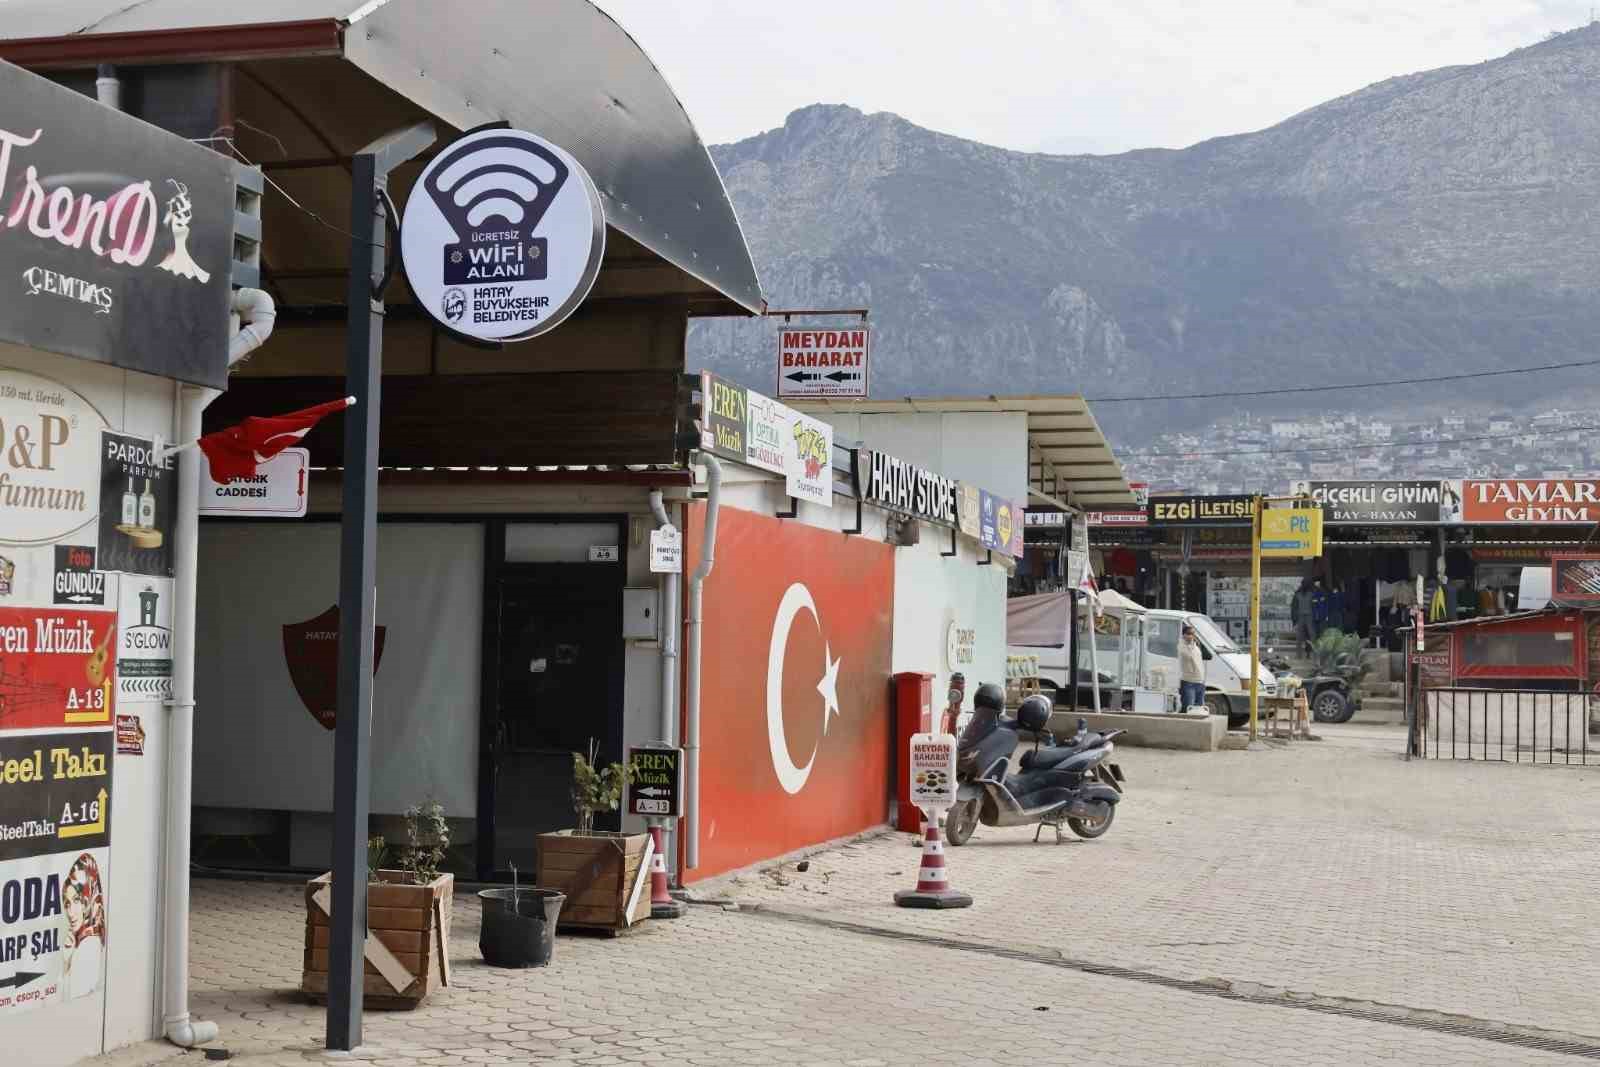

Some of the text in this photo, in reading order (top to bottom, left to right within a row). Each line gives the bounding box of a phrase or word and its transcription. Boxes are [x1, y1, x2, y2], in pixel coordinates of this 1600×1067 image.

[468, 242, 524, 264] WİFİ
[466, 264, 525, 279] ALANI
[472, 286, 513, 297] HATAY
[783, 331, 864, 348] MEYDAN
[783, 352, 863, 367] BAHARAT
[713, 382, 746, 424] EREN
[0, 413, 70, 471] &P
[215, 487, 267, 497] CADDESİ
[872, 450, 915, 509] HATAY
[917, 468, 955, 522] STORE
[1312, 483, 1439, 507] ÇİÇEKLİ GİYİM
[1471, 482, 1600, 503] TAMAR
[1154, 499, 1196, 519] EZGİ
[1505, 504, 1588, 521] GİYİM
[1290, 515, 1310, 533] Ptt
[55, 569, 104, 594] GÜNDÜZ
[35, 617, 94, 653] Müzik
[305, 631, 337, 640] HATAY
[66, 687, 104, 709] A-13
[914, 744, 950, 752] MEYDAN
[914, 753, 949, 761] BAHARAT
[51, 747, 106, 780] Takı
[633, 753, 675, 769] EREN
[60, 801, 99, 824] A-16
[31, 928, 60, 961] ŞAL
